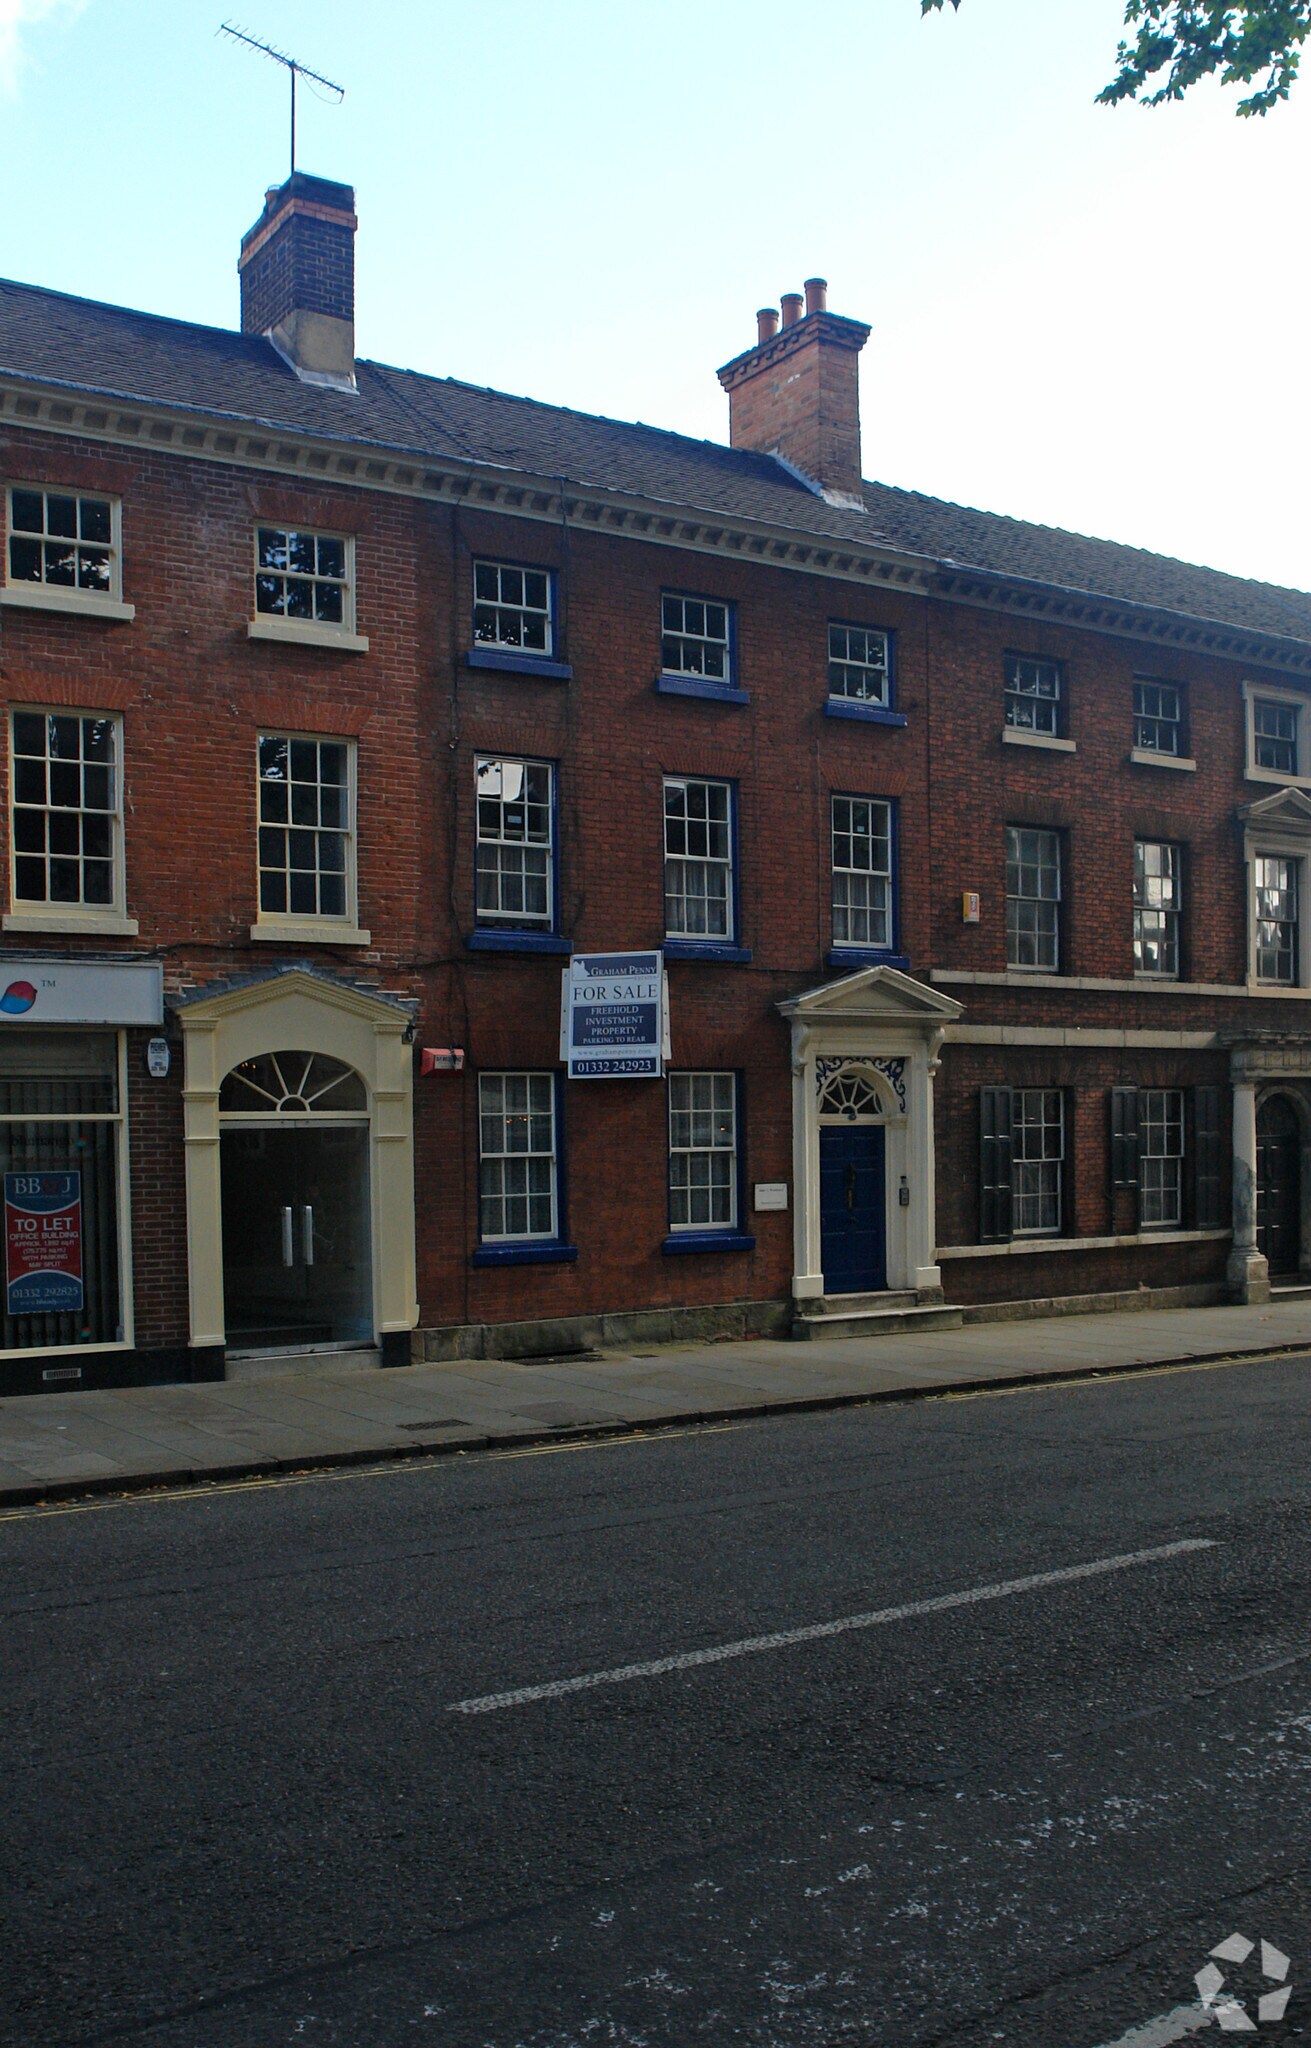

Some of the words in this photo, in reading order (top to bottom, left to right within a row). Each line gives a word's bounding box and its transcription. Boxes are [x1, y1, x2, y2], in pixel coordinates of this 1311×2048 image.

[590, 967, 627, 976] GRAHAM
[629, 965, 656, 974] PENNY
[40, 979, 56, 988] TM
[573, 986, 607, 1000] FOR
[613, 984, 658, 999] SALE
[591, 1005, 639, 1015] FREEHOLD
[585, 1016, 644, 1026] INVESTMENT
[591, 1026, 638, 1036] PROPERTY
[582, 1036, 613, 1044] PARKING
[615, 1035, 625, 1043] TO
[577, 1061, 610, 1072] 01332
[613, 1060, 651, 1071] 242923
[14, 1218, 38, 1232] TO
[43, 1217, 74, 1231] LET
[42, 1231, 79, 1239] BUILDING
[12, 1288, 41, 1298] 01332
[44, 1286, 79, 1297] 292825
